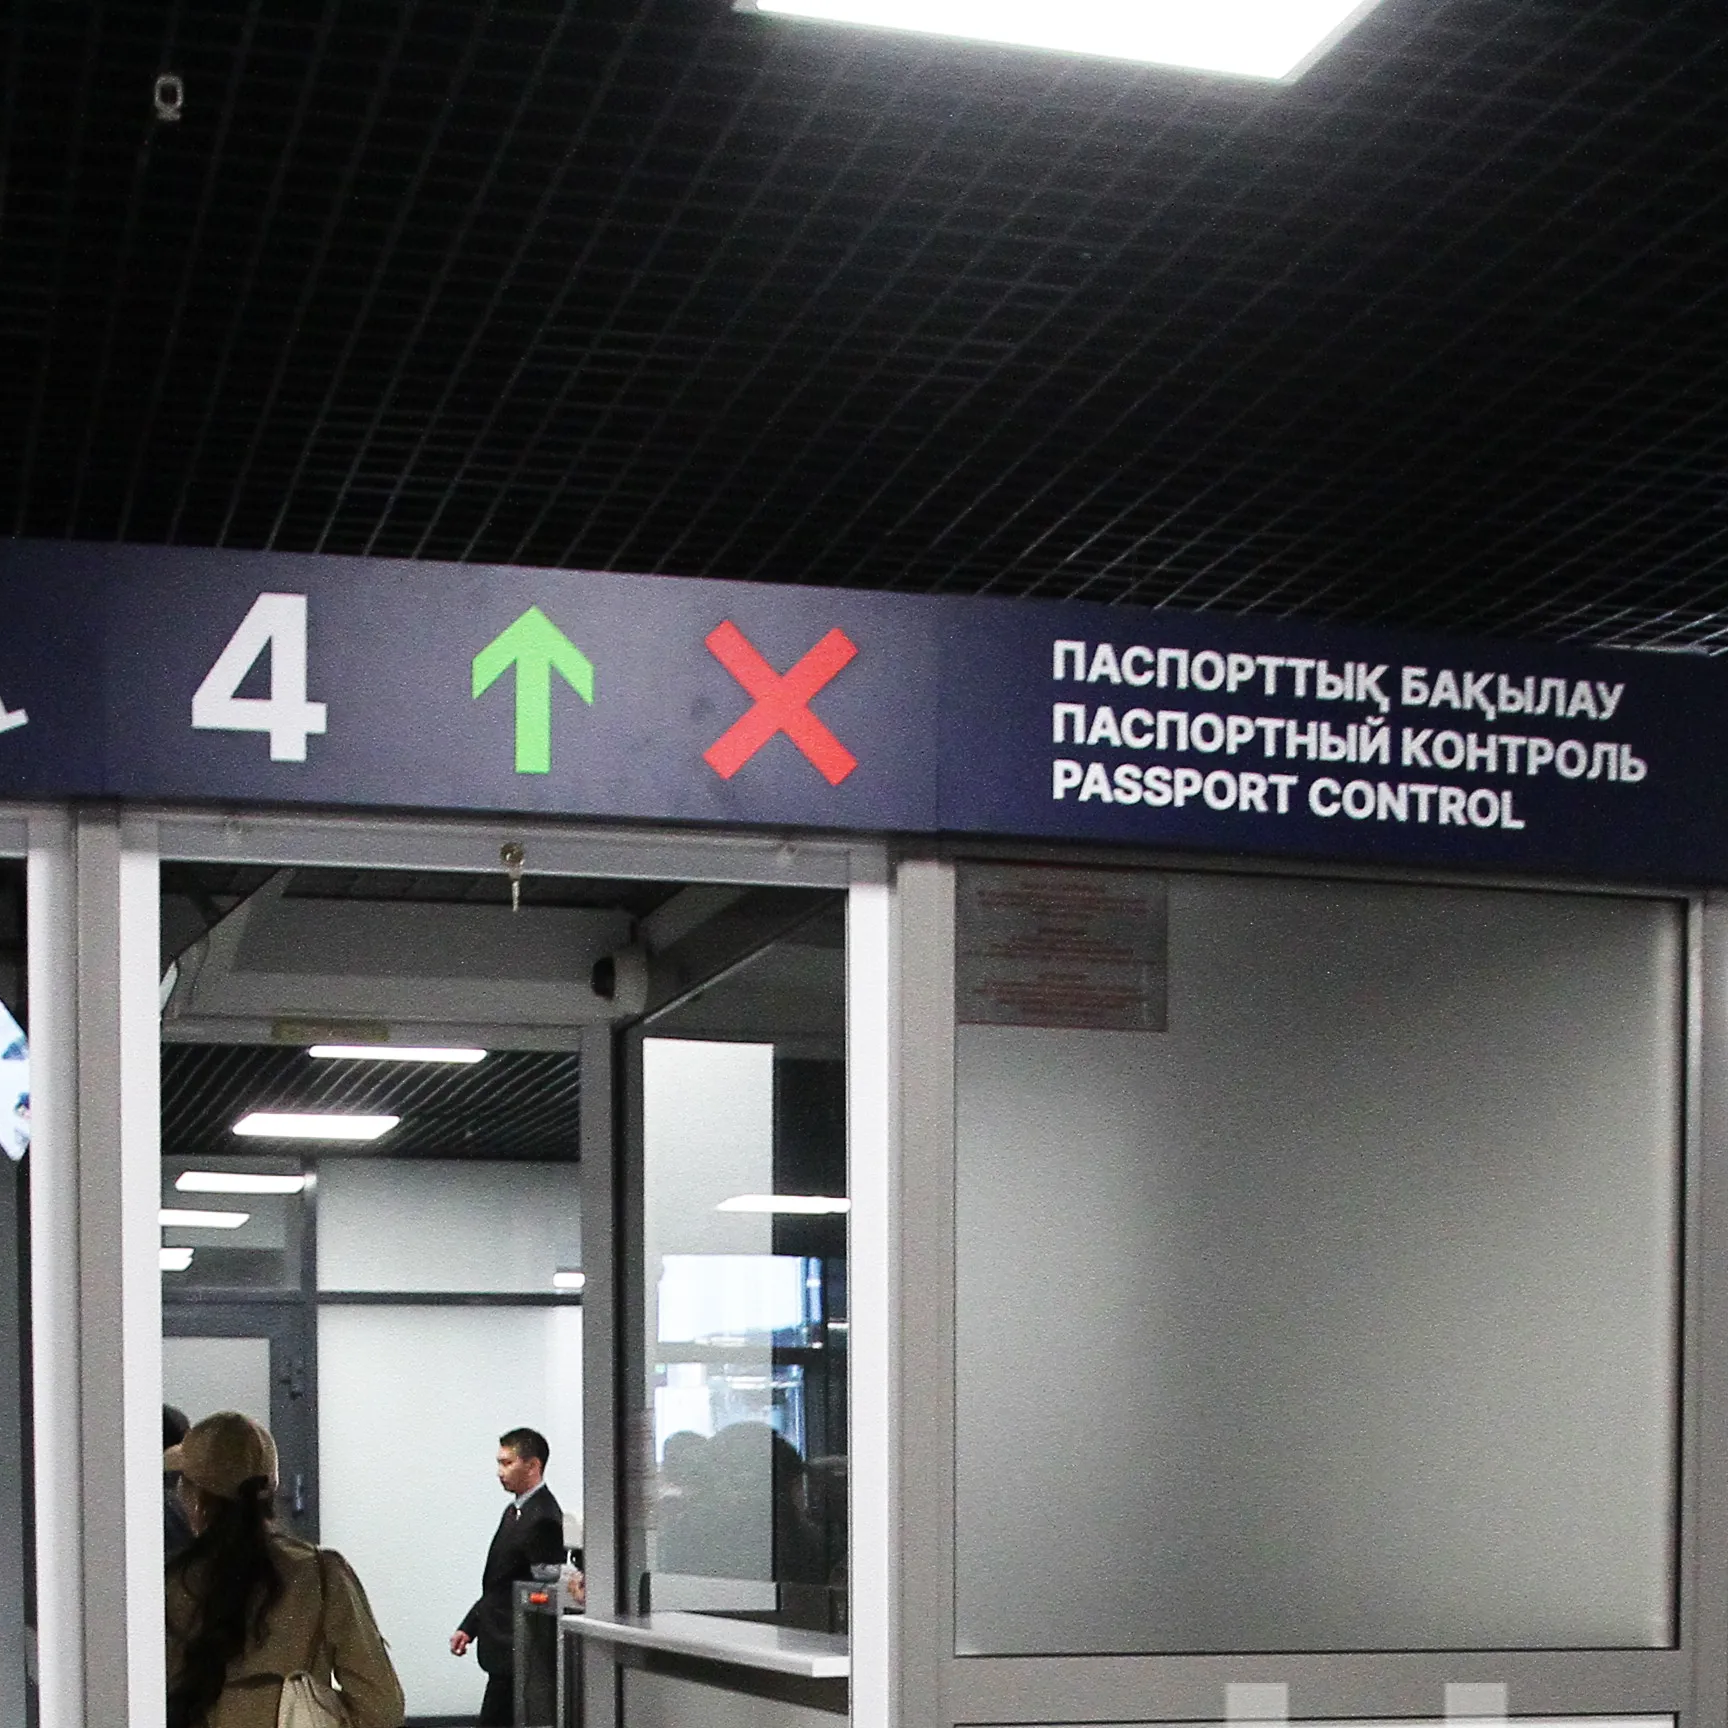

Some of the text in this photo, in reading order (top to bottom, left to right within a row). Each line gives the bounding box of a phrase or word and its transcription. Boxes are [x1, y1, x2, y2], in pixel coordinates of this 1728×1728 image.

[191, 592, 328, 763] 4
[1051, 638, 1626, 722] ПАСПОРТТЫҚ БАҚЫЛАУ
[1051, 701, 1649, 784] ПАСПОРТНЫЙ КОНТРОЛЬ
[1051, 758, 1527, 831] PASSPORT CONTROL
